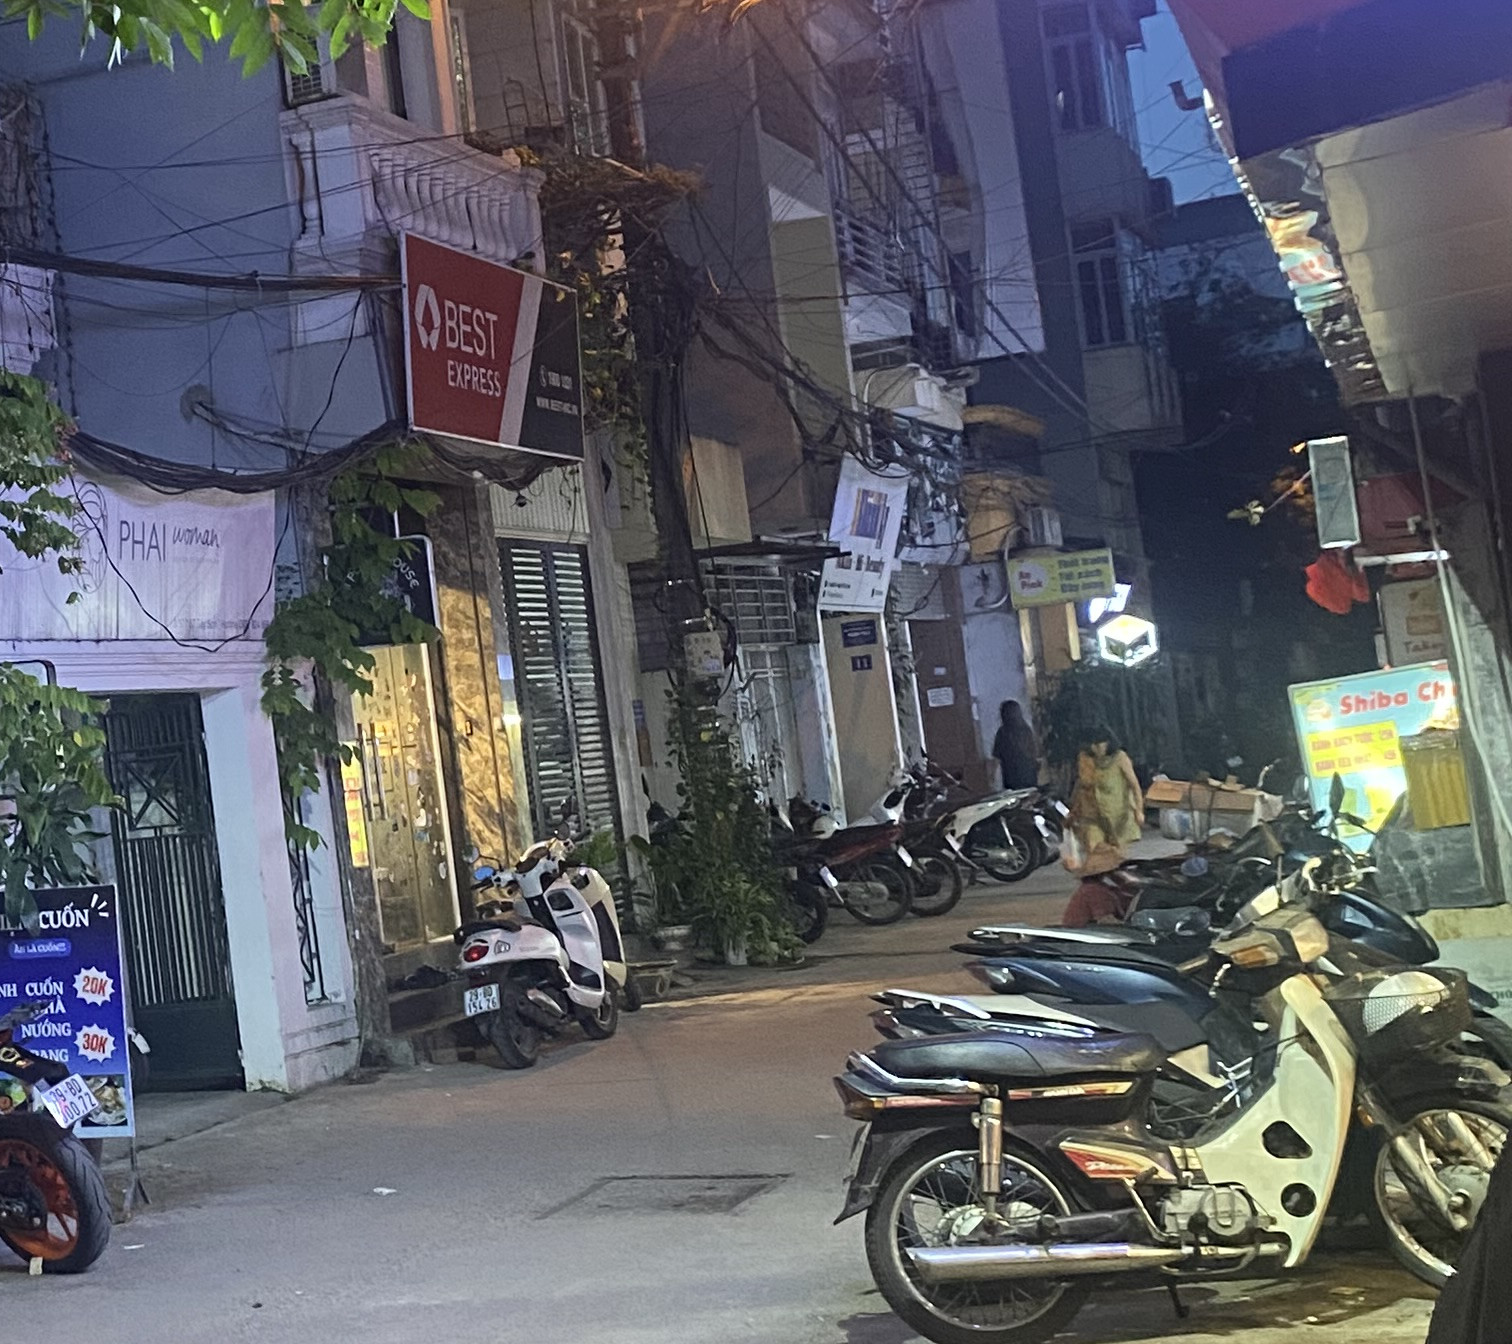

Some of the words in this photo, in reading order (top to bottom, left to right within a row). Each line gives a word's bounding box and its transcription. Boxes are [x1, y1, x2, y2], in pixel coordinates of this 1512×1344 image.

[444, 299, 498, 360] BEST
[448, 359, 501, 398] EXPRESS
[119, 520, 166, 562] PHAI
[172, 526, 220, 549] woman
[392, 557, 420, 589] OUSE
[1340, 690, 1409, 716] Shiba
[39, 902, 89, 929] CUỐN
[25, 976, 64, 997] CUỐN
[82, 975, 108, 997] 20K
[21, 1019, 72, 1039] NƯỚNG
[82, 1033, 108, 1054] 30K
